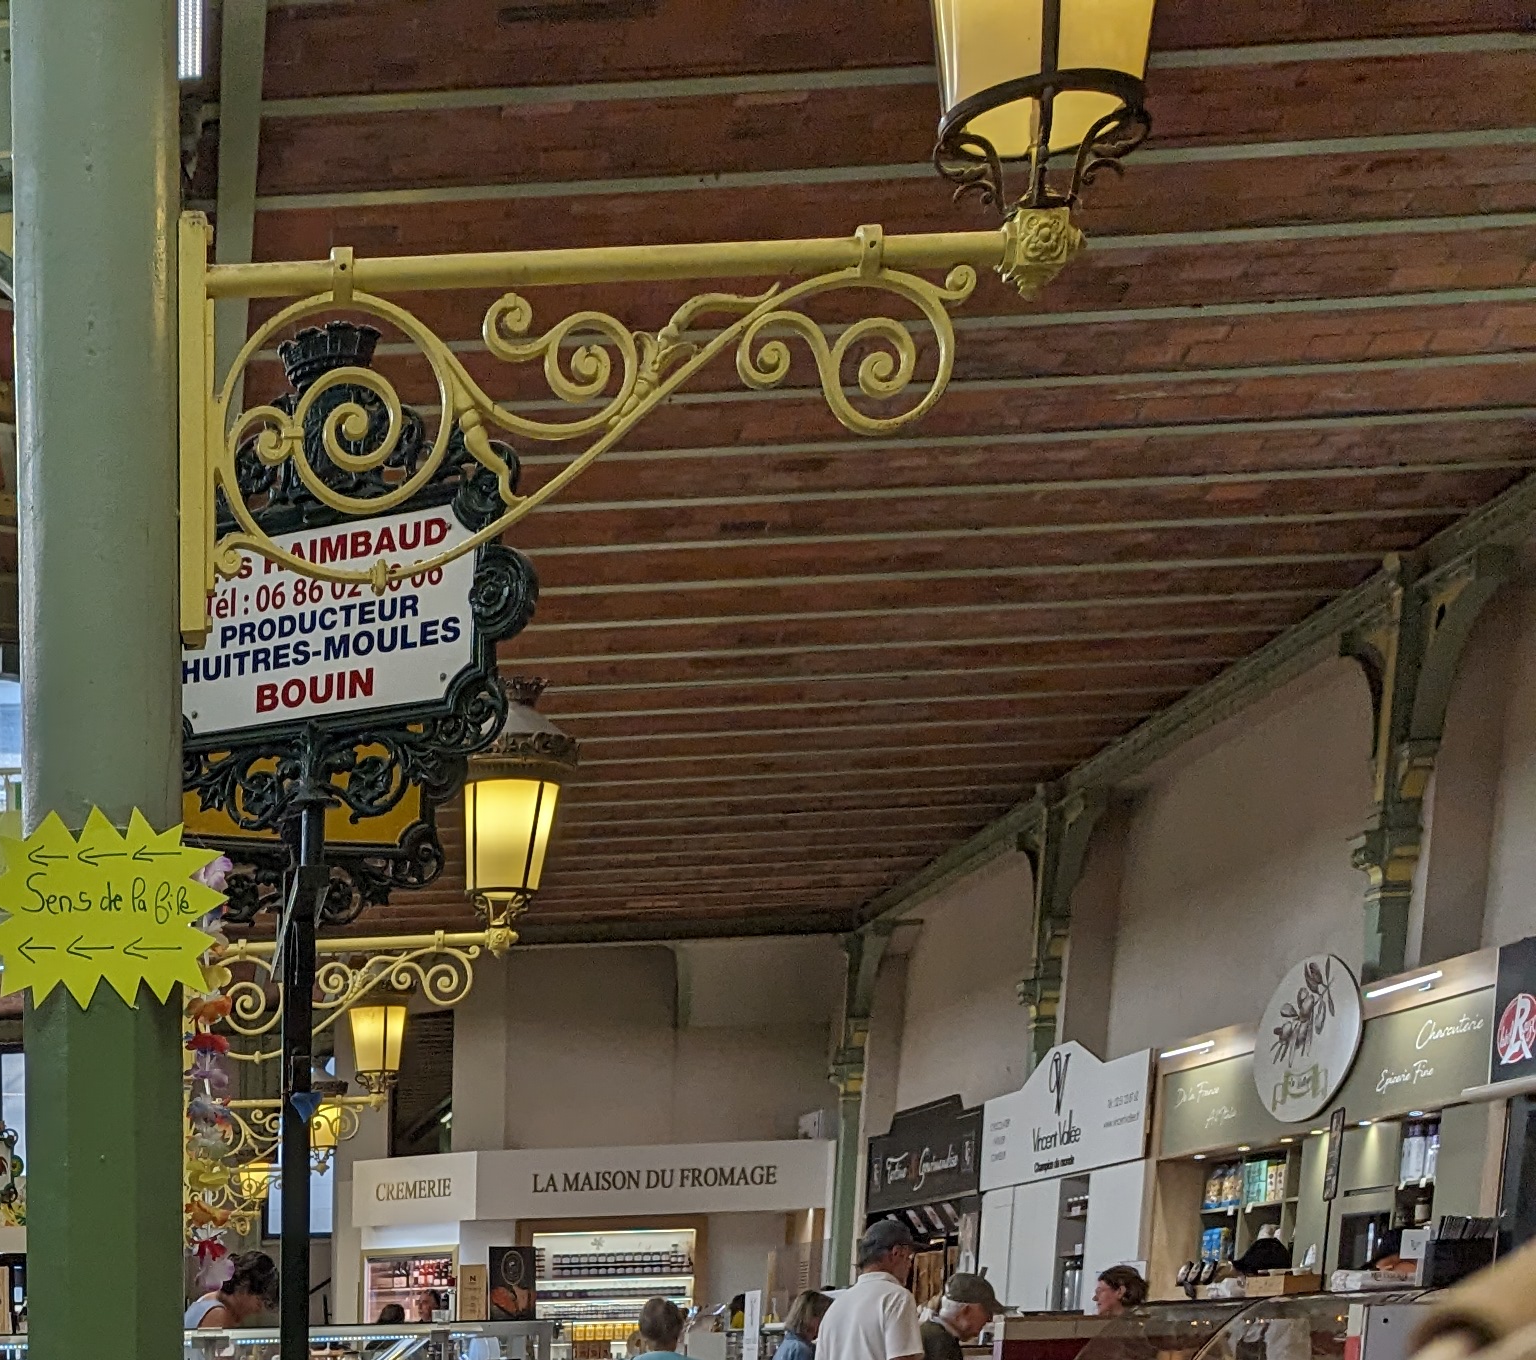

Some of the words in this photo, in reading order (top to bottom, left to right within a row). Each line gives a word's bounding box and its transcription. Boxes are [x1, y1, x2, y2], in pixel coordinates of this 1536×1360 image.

[256, 581, 286, 613] 06
[292, 577, 324, 606] 86
[220, 594, 419, 649] PRODUCTEUR
[182, 616, 461, 684] HUITRES-MOULES
[256, 667, 374, 713] BOUIN
[21, 872, 92, 914] Sens
[99, 881, 124, 912] de
[131, 877, 148, 913] la
[154, 881, 199, 925] file
[1415, 1013, 1485, 1050] Charcuterie
[1032, 1126, 1058, 1153] Vincent
[376, 1178, 452, 1201] CREMERIE
[532, 1173, 559, 1193] LA
[562, 1170, 641, 1193] MAISON
[645, 1168, 674, 1190] DU
[679, 1165, 778, 1188] FROMAGE
